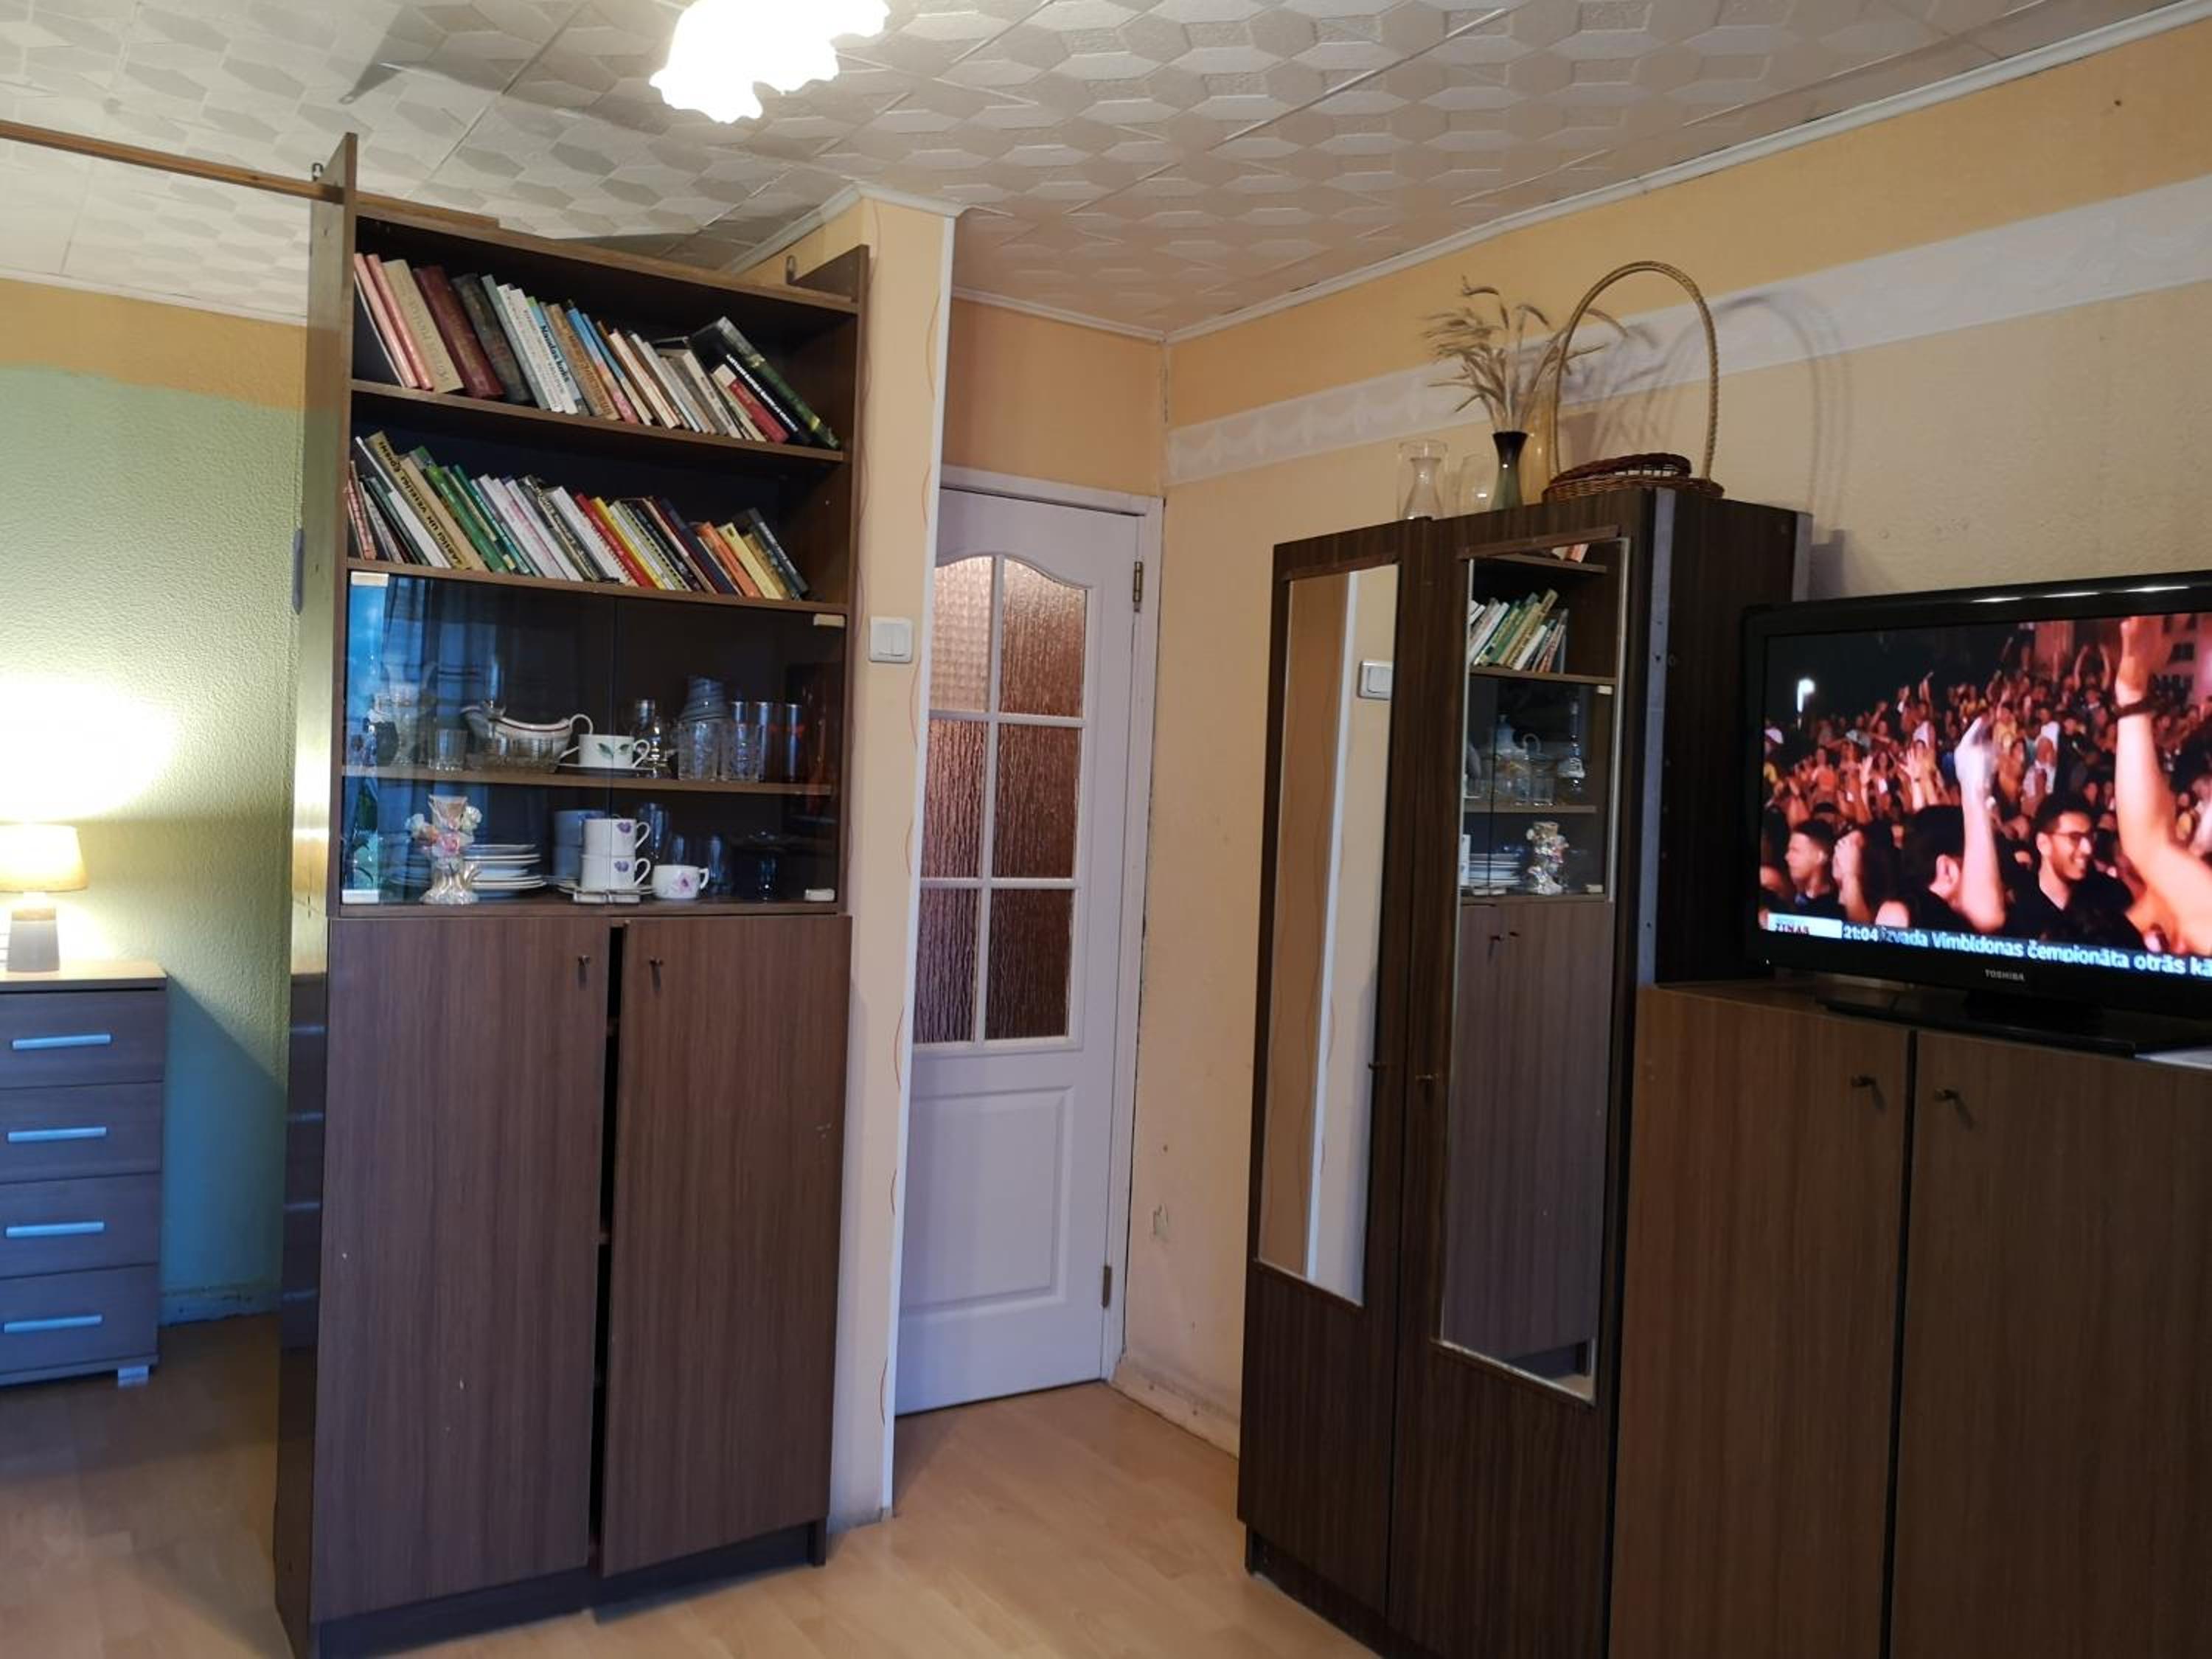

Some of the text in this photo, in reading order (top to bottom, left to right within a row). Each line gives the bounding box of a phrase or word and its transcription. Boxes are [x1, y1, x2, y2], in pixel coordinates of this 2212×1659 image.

[1843, 925, 1879, 942] 21:04
[1931, 931, 2024, 957] Vimbldonas
[2027, 939, 2130, 969] čempionāta
[2133, 953, 2186, 974] otrās
[1985, 969, 2025, 982] TOSHIBA
